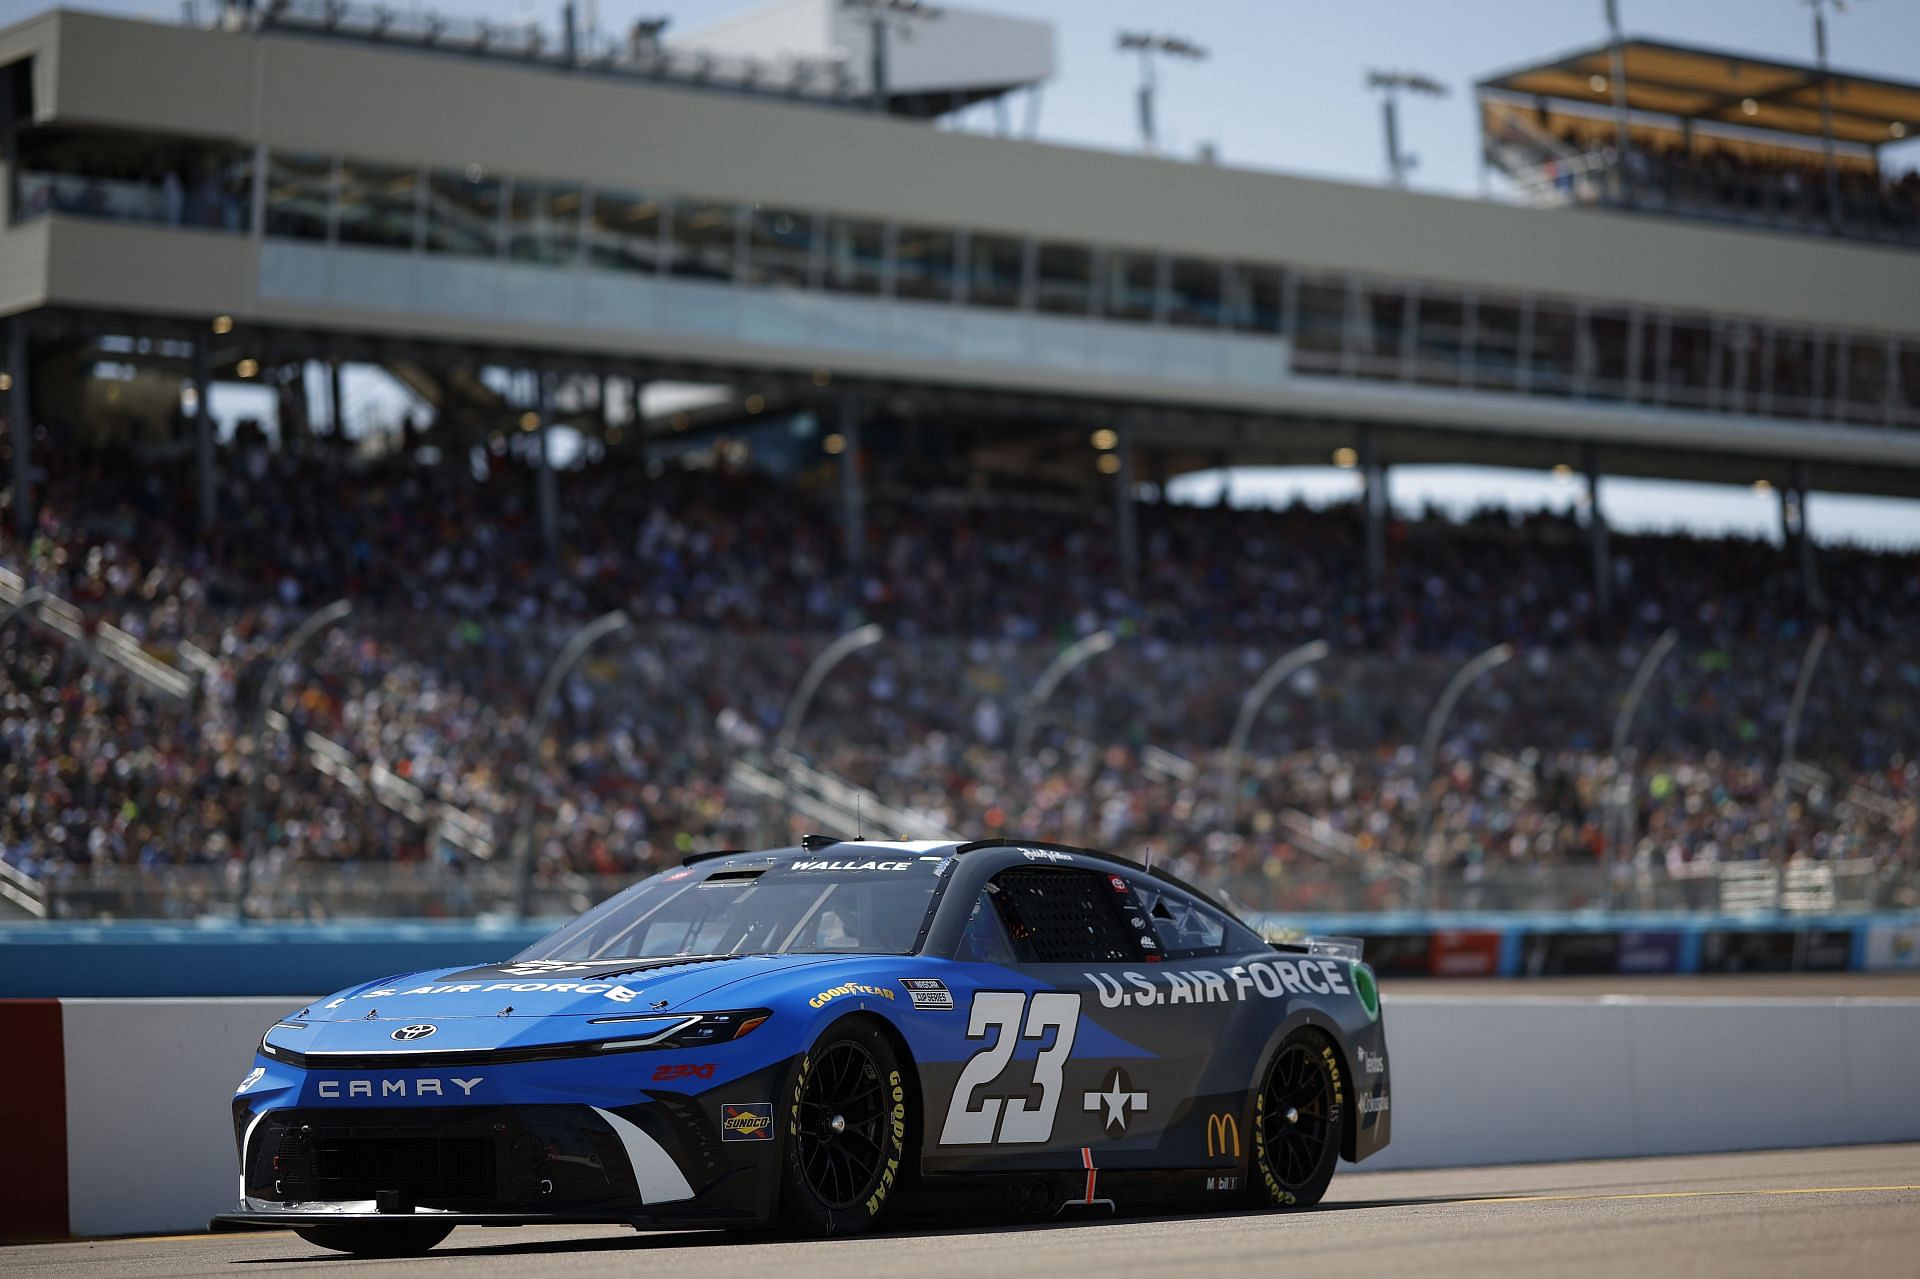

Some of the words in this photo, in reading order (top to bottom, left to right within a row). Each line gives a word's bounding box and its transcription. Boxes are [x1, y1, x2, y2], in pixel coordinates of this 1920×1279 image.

[791, 861, 912, 871] WALLACE
[400, 984, 482, 996] AIR
[483, 982, 645, 1003] FORCE
[809, 982, 895, 1009] GOODYEAR
[927, 993, 946, 1002] SERIES
[1083, 971, 1164, 1008] U.S.
[1161, 970, 1230, 1004] AIR
[1222, 961, 1350, 1001] FORCE
[939, 992, 1081, 1145] 23
[1322, 1046, 1344, 1105] EAGLE
[318, 1077, 485, 1098] CAMRY
[790, 1055, 810, 1137] EAGLE
[725, 1117, 769, 1129] SUNOCO
[865, 1070, 905, 1216] GOODYEAR
[1255, 1093, 1297, 1205] GOODYEAR
[1206, 1177, 1229, 1190] Mbil
